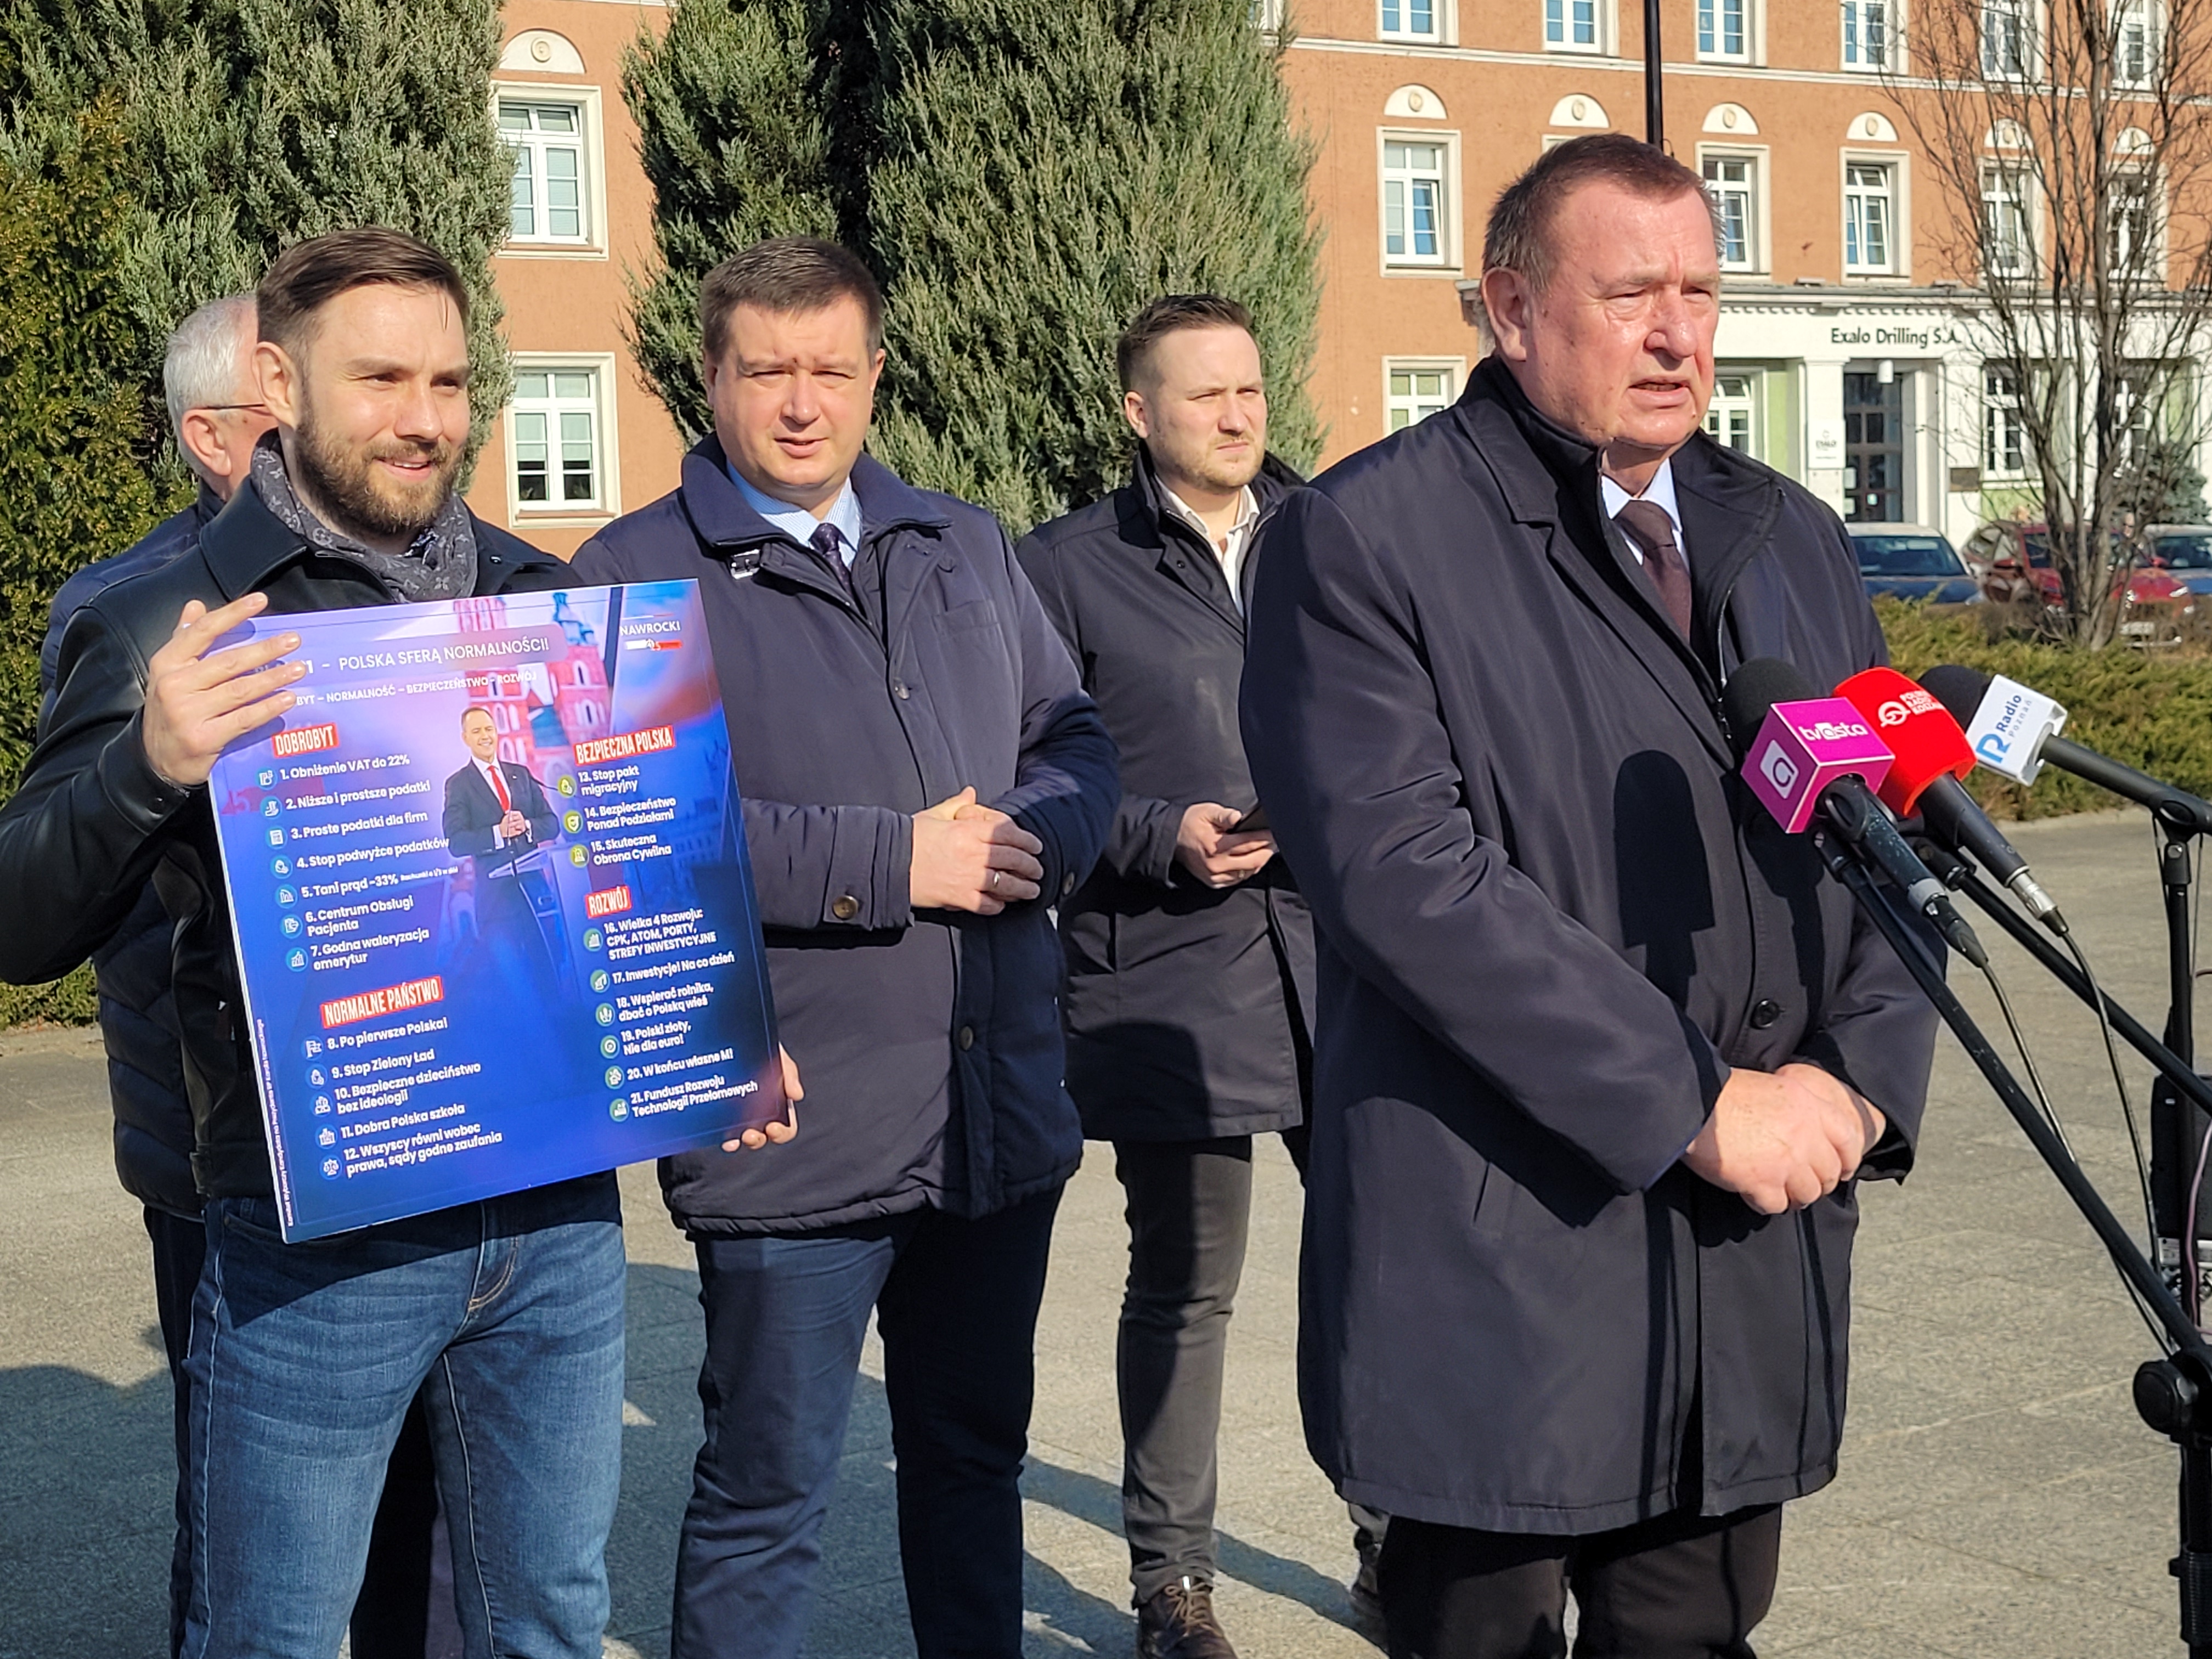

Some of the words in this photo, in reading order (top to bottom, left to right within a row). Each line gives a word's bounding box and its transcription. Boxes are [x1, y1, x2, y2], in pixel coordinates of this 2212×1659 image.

[1831, 326, 1870, 344] Exalo
[1876, 328, 1927, 349] Drilling
[619, 620, 681, 636] NAWROCKI
[339, 653, 396, 670] POLSKA
[398, 648, 443, 665] SFERĄ
[444, 636, 549, 659] NORMALNOŚCI!
[326, 685, 396, 703] NORMALNOŚĆ
[407, 675, 489, 694] BEZPIECZEŃSTWO
[497, 670, 537, 685] ROZWÓJ
[1996, 695, 2022, 732] Radio
[2008, 699, 2033, 738] Poznań
[275, 725, 334, 755] DOBROBYT
[575, 738, 635, 764] BEZPIECZNA
[635, 727, 673, 752] POLSKA
[280, 769, 289, 780] 1.
[290, 761, 347, 778] Obniżenie
[347, 759, 370, 771] VAT
[372, 757, 386, 768] do
[387, 754, 410, 766] 22%
[578, 772, 592, 783] 13.
[592, 768, 615, 782] Stop
[616, 765, 640, 779] pakt
[286, 798, 297, 810] 2.
[298, 793, 333, 808] Niższe
[335, 792, 339, 803] i
[340, 786, 387, 805] prostsze
[388, 780, 431, 797] podatki
[581, 779, 638, 796] migracyjny
[584, 808, 599, 819] 14.
[599, 796, 676, 816] Bezpieczeństwo
[586, 817, 619, 831] Ponad
[620, 809, 674, 826] Podziałami
[291, 828, 302, 839] 3.
[303, 822, 339, 838] Proste
[341, 816, 385, 836] podatki
[386, 814, 403, 827] dla
[404, 811, 428, 823] firm
[296, 857, 308, 868] 4.
[309, 851, 336, 868] Stop
[337, 844, 393, 866] podwyżce
[394, 838, 450, 857] podatków
[591, 840, 605, 853] 15.
[605, 834, 657, 850] Skuteczna
[593, 850, 631, 866] Obrona
[632, 844, 672, 862] Cywilna
[301, 887, 313, 898] 5.
[314, 881, 340, 896] Tani
[340, 877, 368, 895] prąd
[588, 886, 628, 916] ROZWÓJ
[305, 911, 317, 922] 6.
[318, 904, 369, 921] Centrum
[370, 895, 414, 913] Obsługi
[308, 918, 359, 936] Pacjenta
[604, 922, 618, 934] 16.
[618, 917, 652, 932] Wielka
[653, 915, 661, 926] 4
[607, 934, 630, 947] CPK,
[631, 928, 662, 943] ATOM,
[663, 922, 697, 938] PORTY,
[311, 945, 321, 957] 7.
[322, 939, 361, 954] Godna
[362, 927, 430, 947] waloryzacja
[609, 946, 644, 961] STREFY
[644, 932, 716, 955] INWESTYCYJNE
[313, 953, 368, 970] emerytur
[612, 972, 625, 984] 17.
[682, 959, 696, 970] Na
[696, 958, 708, 968] co
[709, 951, 735, 966] dzień
[325, 991, 386, 1025] NORMALNE
[387, 979, 439, 1009] PAŃSTWO
[616, 997, 630, 1009] 18.
[631, 987, 676, 1006] Wspierać
[677, 982, 714, 997] rolnika,
[618, 1006, 645, 1022] dbać
[645, 1008, 652, 1017] o
[653, 1001, 685, 1015] Polską
[686, 995, 708, 1009] wieś
[328, 1038, 338, 1049] 8.
[340, 1035, 354, 1047] Po
[356, 1028, 406, 1047] pierwsze
[407, 1017, 448, 1035] Polska!
[621, 1030, 635, 1043] 19.
[635, 1023, 664, 1039] Polski
[664, 1019, 691, 1035] złoty,
[623, 1044, 642, 1056] Nie
[643, 1039, 658, 1052] dla
[658, 1035, 684, 1050] euro!
[331, 1068, 343, 1079] 9.
[344, 1062, 370, 1076] Stop
[371, 1054, 412, 1071] Zielony
[414, 1048, 435, 1063] Ład
[628, 1068, 642, 1080] 20.
[642, 1065, 653, 1076] W
[654, 1058, 686, 1075] końcu
[685, 1052, 720, 1068] własne
[335, 1088, 351, 1101] 10.
[352, 1076, 415, 1097] Bezpieczne
[416, 1063, 481, 1084] dzieciństwo
[631, 1092, 643, 1104] 21.
[644, 1082, 685, 1102] Fundusz
[685, 1075, 725, 1093] Rozwoju
[337, 1099, 359, 1115] bez
[359, 1089, 409, 1110] ideologii
[633, 1098, 689, 1118] Technologii
[690, 1080, 759, 1106] Przełomowych
[341, 1127, 354, 1138] 11.
[355, 1119, 390, 1136] Dobra
[391, 1112, 428, 1128] Polska
[430, 1103, 465, 1120] szkoła
[344, 1149, 359, 1161] 12.
[360, 1138, 410, 1158] Wszyscy
[411, 1128, 443, 1146] równi
[444, 1123, 481, 1141] wobec
[346, 1159, 388, 1178] prawa,
[388, 1150, 416, 1166] sądy
[417, 1142, 453, 1161] godne
[454, 1131, 503, 1152] zaufania
